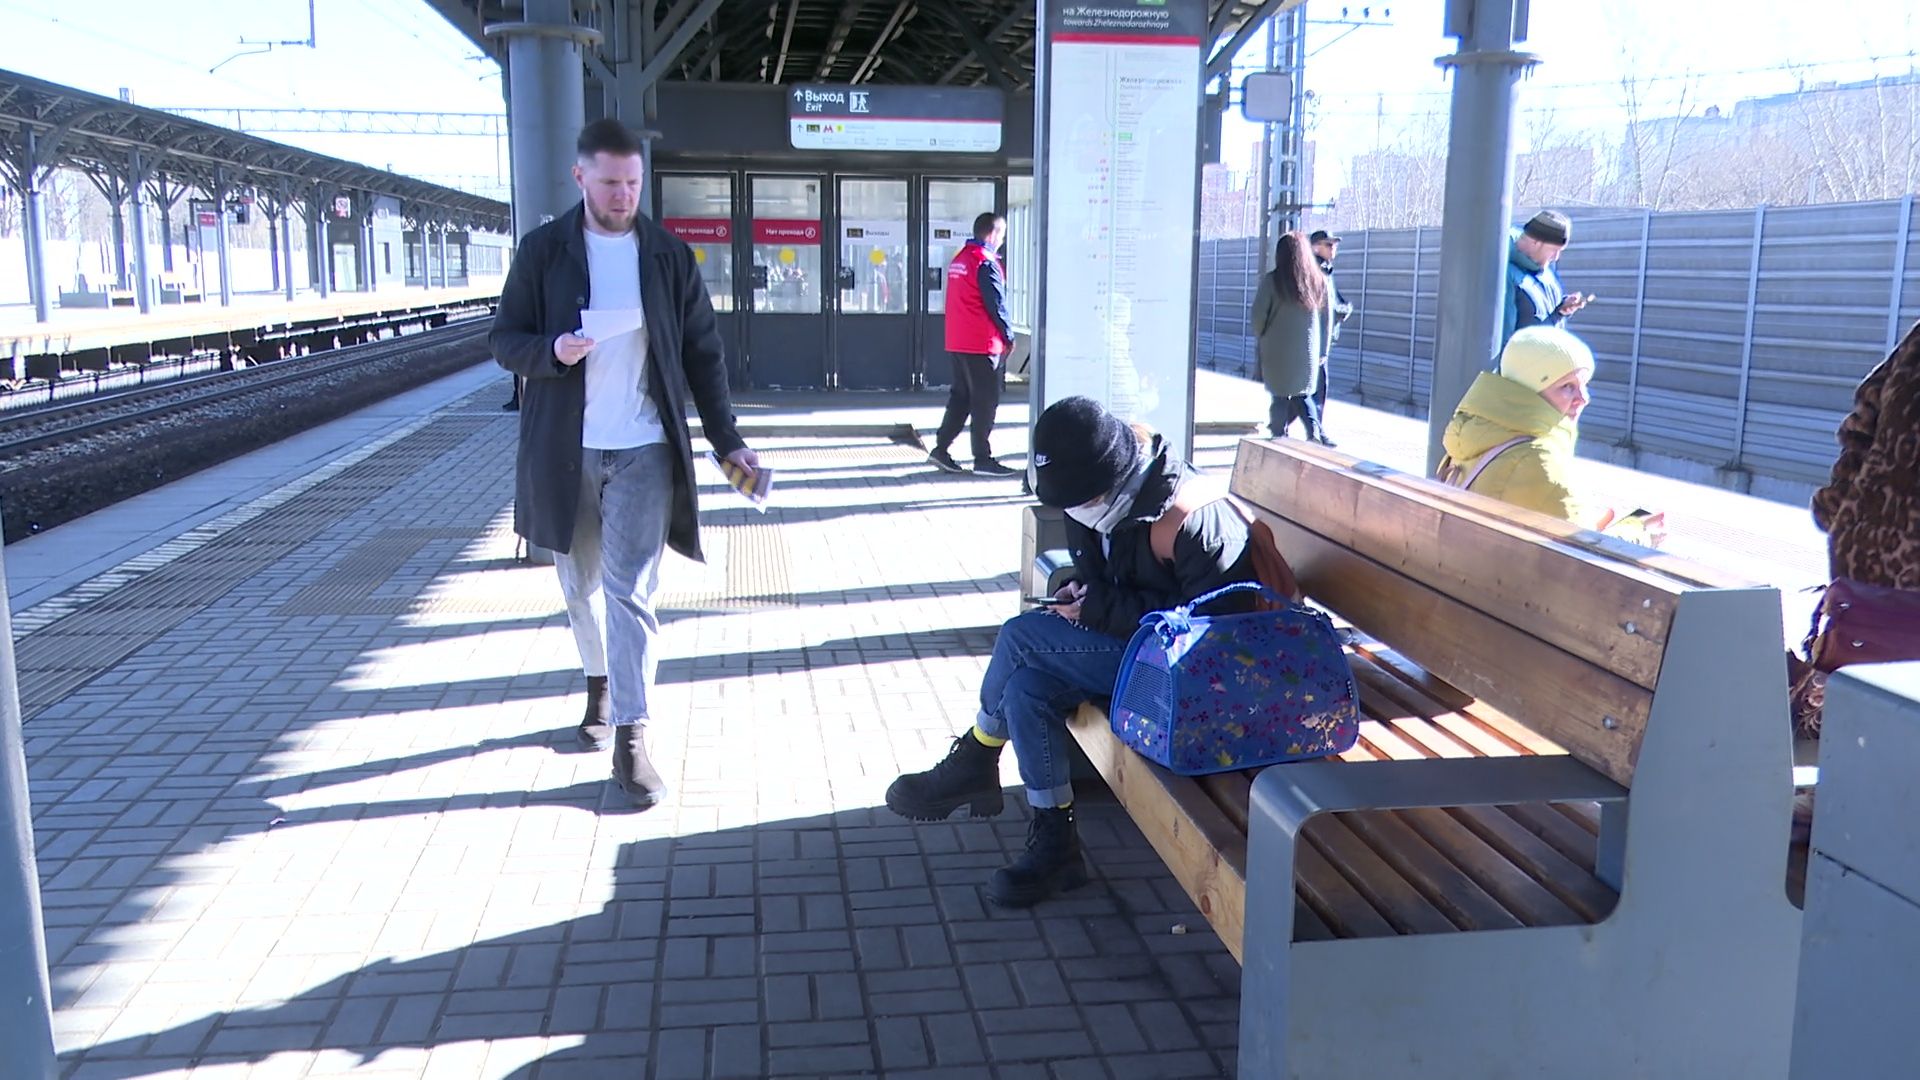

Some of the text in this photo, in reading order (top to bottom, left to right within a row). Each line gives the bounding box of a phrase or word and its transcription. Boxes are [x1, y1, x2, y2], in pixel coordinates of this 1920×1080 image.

[1062, 7, 1169, 20] на Железнодорожную
[1063, 19, 1093, 27] towards
[805, 90, 844, 104] Выход
[805, 103, 822, 112] Exit
